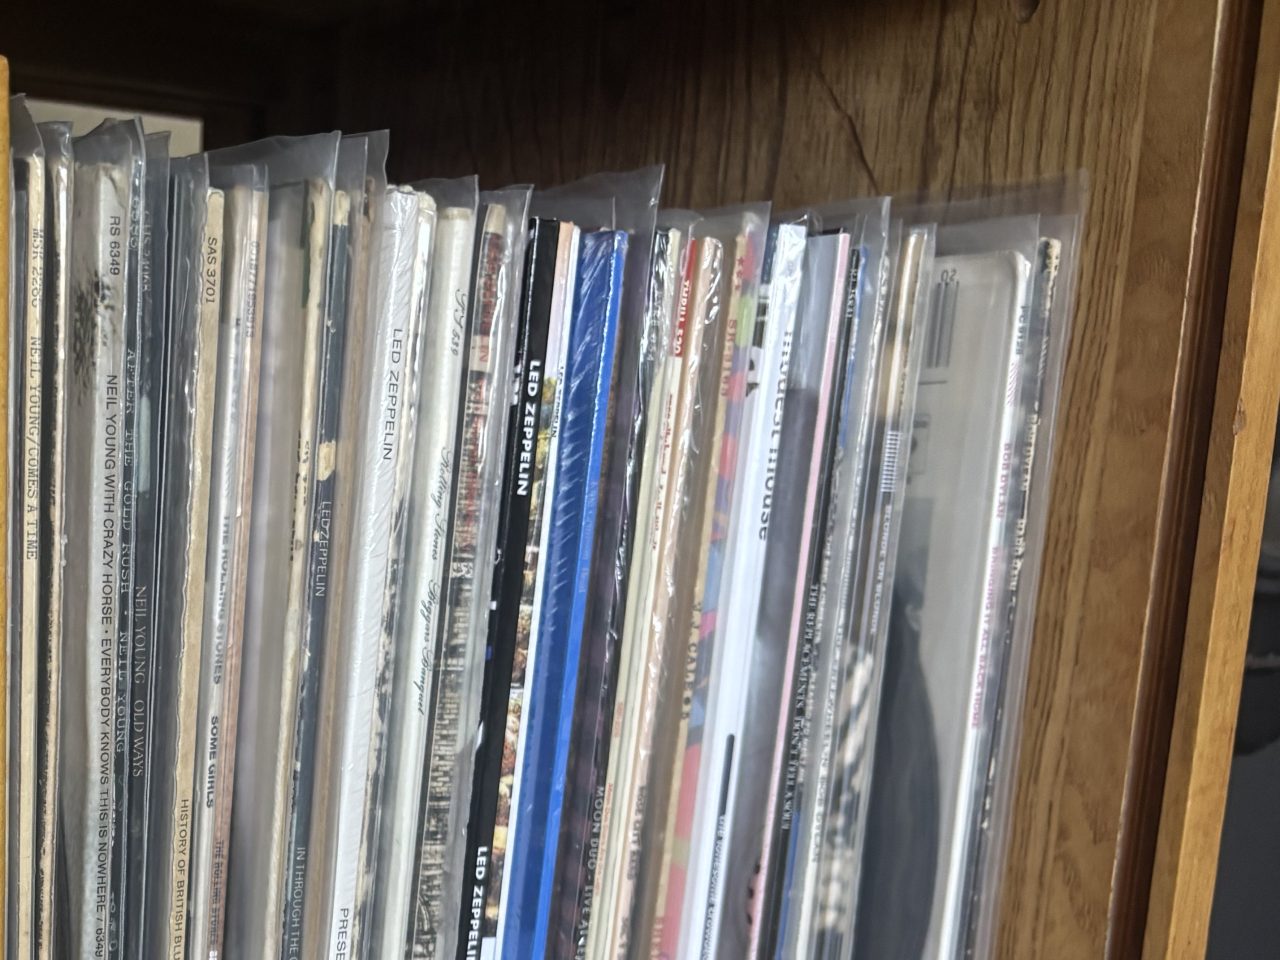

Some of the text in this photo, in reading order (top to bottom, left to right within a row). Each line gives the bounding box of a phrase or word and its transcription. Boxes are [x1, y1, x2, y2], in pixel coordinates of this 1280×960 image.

[109, 215, 120, 276] RS 6349
[205, 236, 218, 303] SAS 3701
[391, 327, 403, 364] LED
[527, 359, 541, 396] LED
[382, 369, 399, 461] ZEPPELIN
[26, 336, 42, 559] NEIL YOUNG/COMES A TIME
[123, 429, 134, 466] THE
[516, 402, 537, 496] ZEPPELIN
[122, 481, 133, 530] GOLD
[319, 500, 332, 529] LED
[412, 330, 460, 719] 539 Rolling Stones Beggars Banquet
[120, 543, 131, 594] RUSH
[314, 529, 329, 597] ZEPPELIN
[95, 373, 117, 912] NEIL YOUNG WITH CRAZY HORSE EVERYBODY KNOWS THIS IS NOWHERE
[117, 630, 128, 679] NEIL
[131, 584, 147, 777] NEIL YOUNG OLD WAYS
[208, 715, 219, 759] SOME
[205, 763, 217, 808] GIRLS
[173, 798, 189, 932] HISTORY OF BRITISH
[296, 846, 306, 860] IN
[474, 845, 488, 880] LED
[580, 785, 604, 914] MOON DUO LIVE
[291, 863, 305, 927] THROUGH
[289, 930, 300, 953] THE
